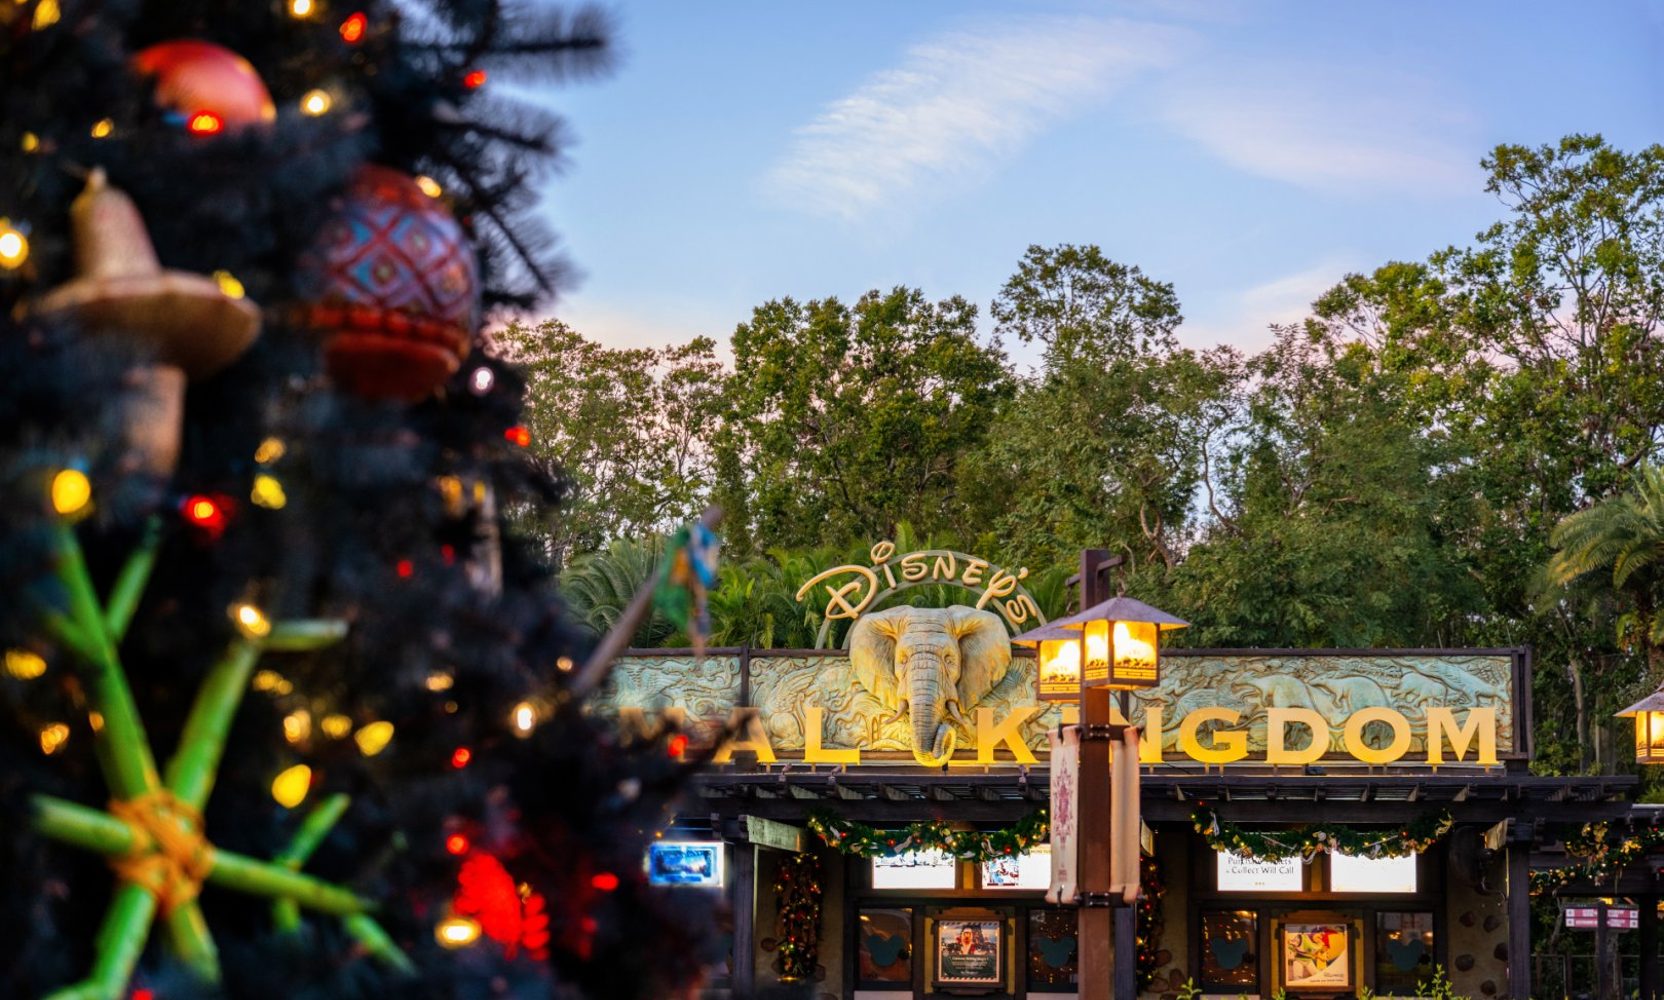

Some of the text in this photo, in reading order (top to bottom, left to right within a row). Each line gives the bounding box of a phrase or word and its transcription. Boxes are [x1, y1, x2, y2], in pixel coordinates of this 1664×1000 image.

[976, 706, 1500, 765] KNGDOM
[1231, 866, 1259, 874] Collect
[1261, 866, 1277, 874] Will
[1279, 866, 1294, 874] Call
